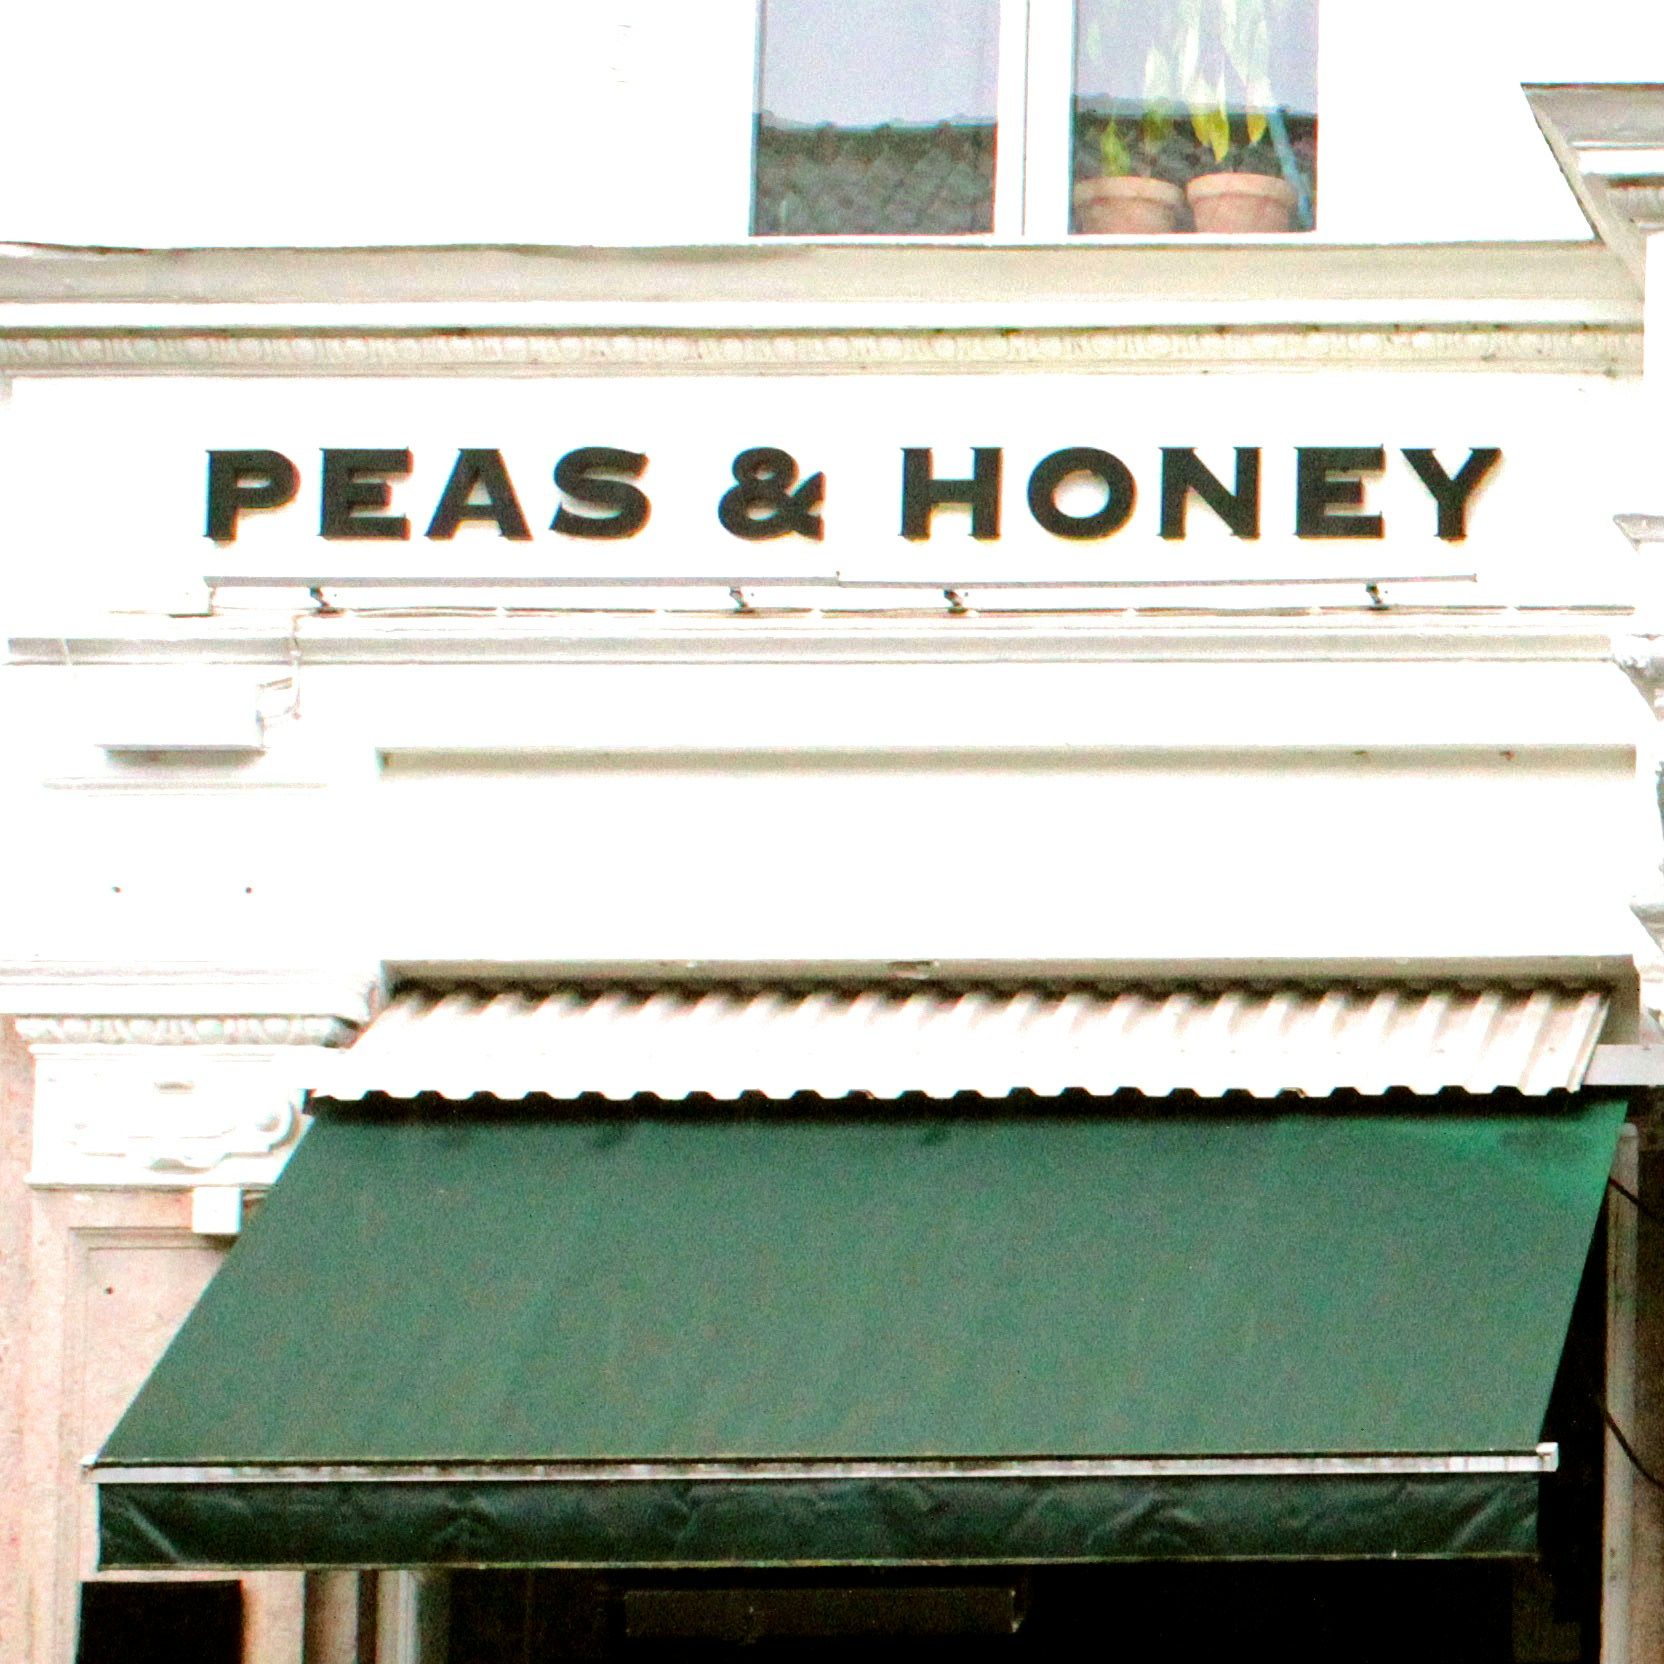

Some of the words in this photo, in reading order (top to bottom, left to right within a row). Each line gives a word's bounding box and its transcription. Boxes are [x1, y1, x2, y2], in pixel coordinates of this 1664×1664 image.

[203, 446, 650, 542] PEAS
[717, 446, 824, 541] &
[900, 446, 1502, 542] HONEY
